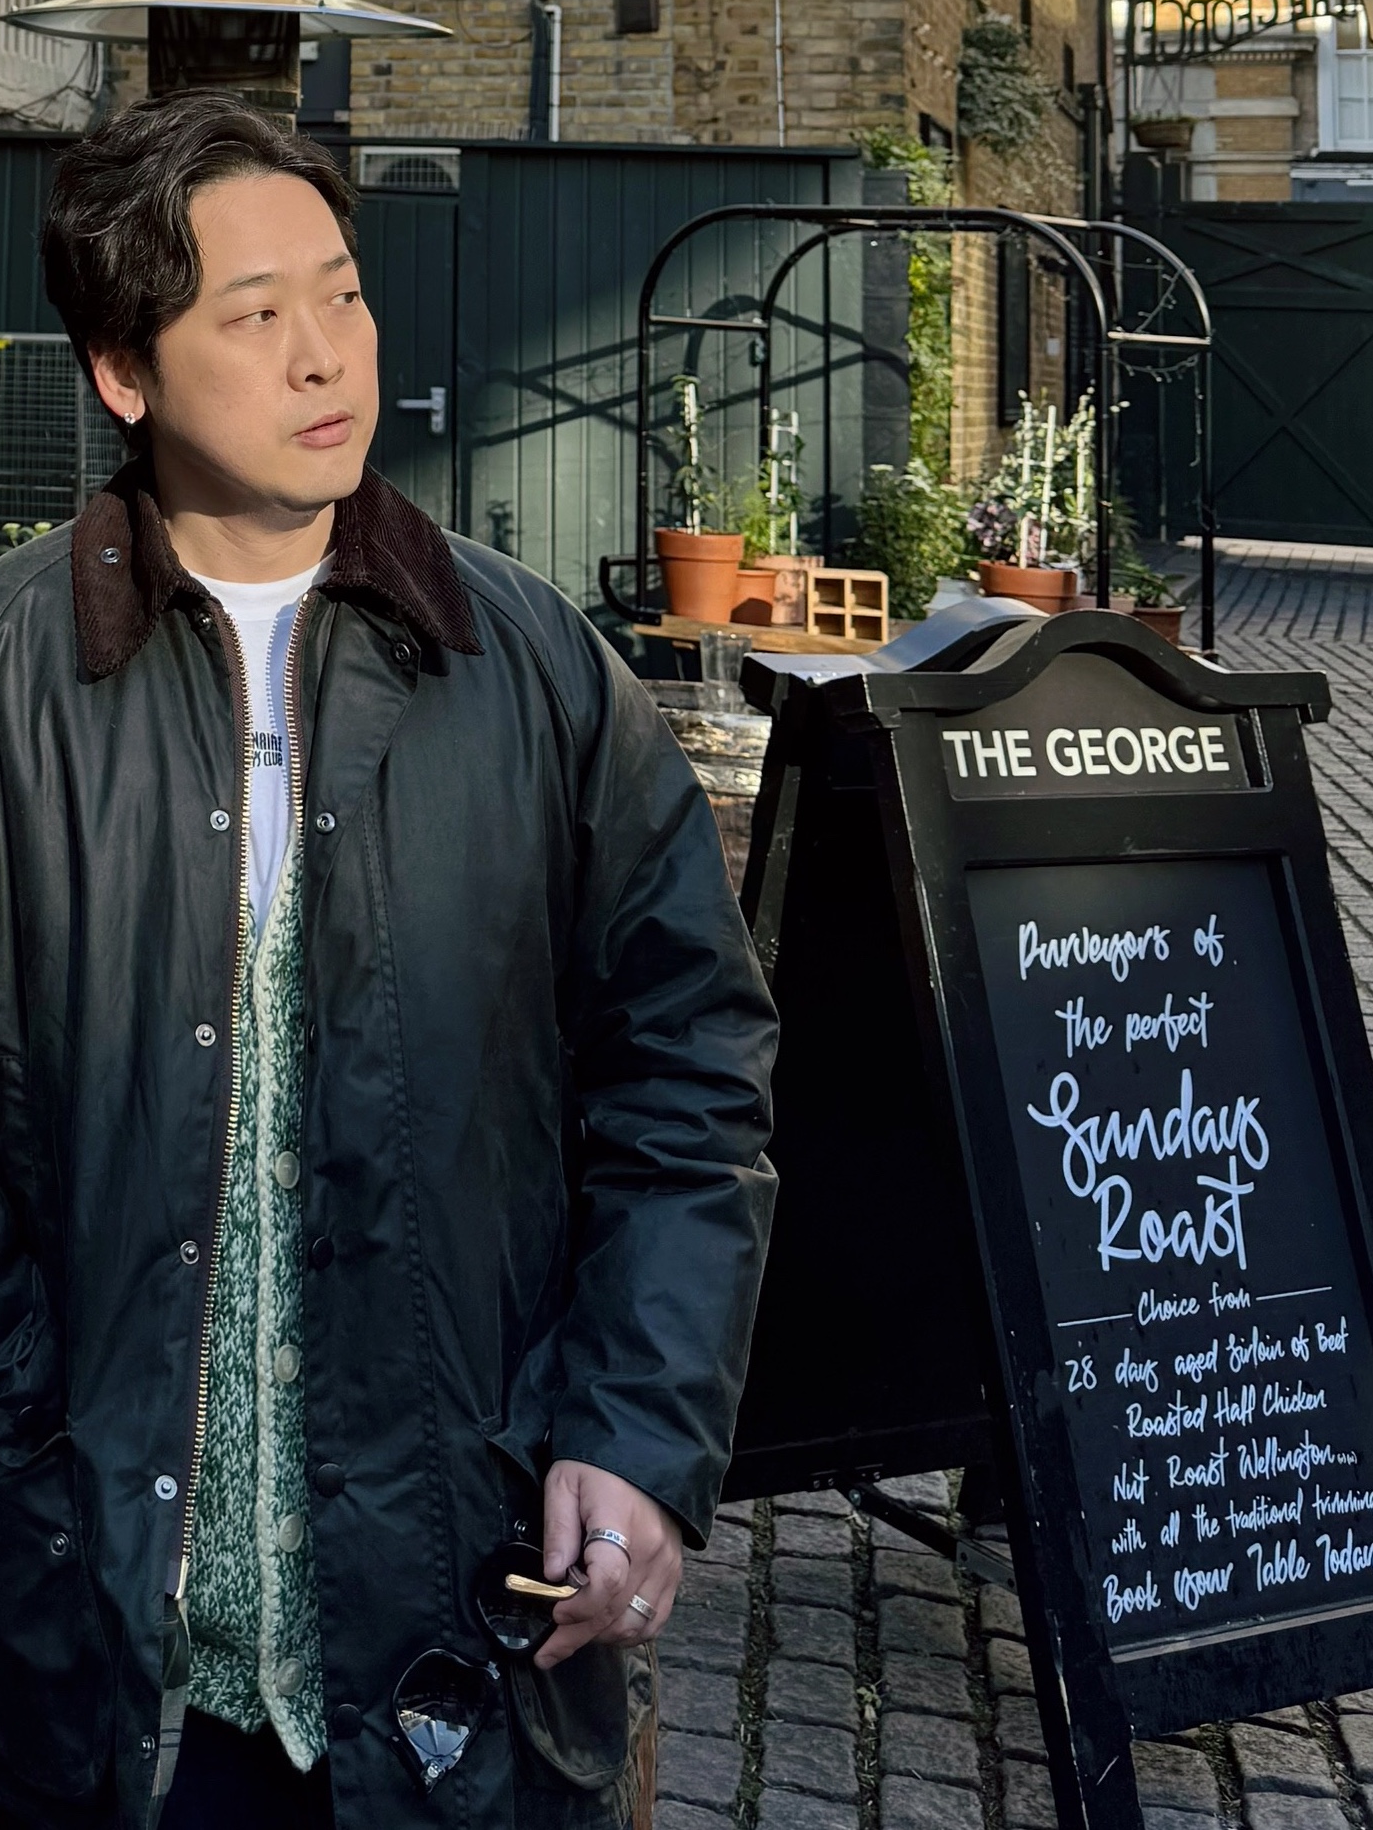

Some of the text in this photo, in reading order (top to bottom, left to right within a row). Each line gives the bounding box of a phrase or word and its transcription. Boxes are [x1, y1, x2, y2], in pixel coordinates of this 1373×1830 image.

[942, 726, 1230, 778] THE GEORGE
[1193, 914, 1225, 967] of
[1054, 991, 1214, 1058] the perfect
[1027, 1068, 1270, 1198] Sunday
[1090, 1155, 1256, 1272] Roast
[1138, 1281, 1251, 1326] Choice from
[1064, 1354, 1098, 1393] 28
[1174, 1338, 1219, 1384] aged
[1290, 1324, 1310, 1362] of
[1314, 1315, 1349, 1354] Beef
[1126, 1379, 1328, 1438] Roasted Half Chicken
[1113, 1458, 1150, 1505] Nut
[1166, 1436, 1230, 1488] Roast
[1237, 1429, 1336, 1481] Wellington
[1111, 1483, 1373, 1555] with all the traditional trimmin
[1102, 1570, 1162, 1624] Book
[1246, 1538, 1311, 1592] Table
